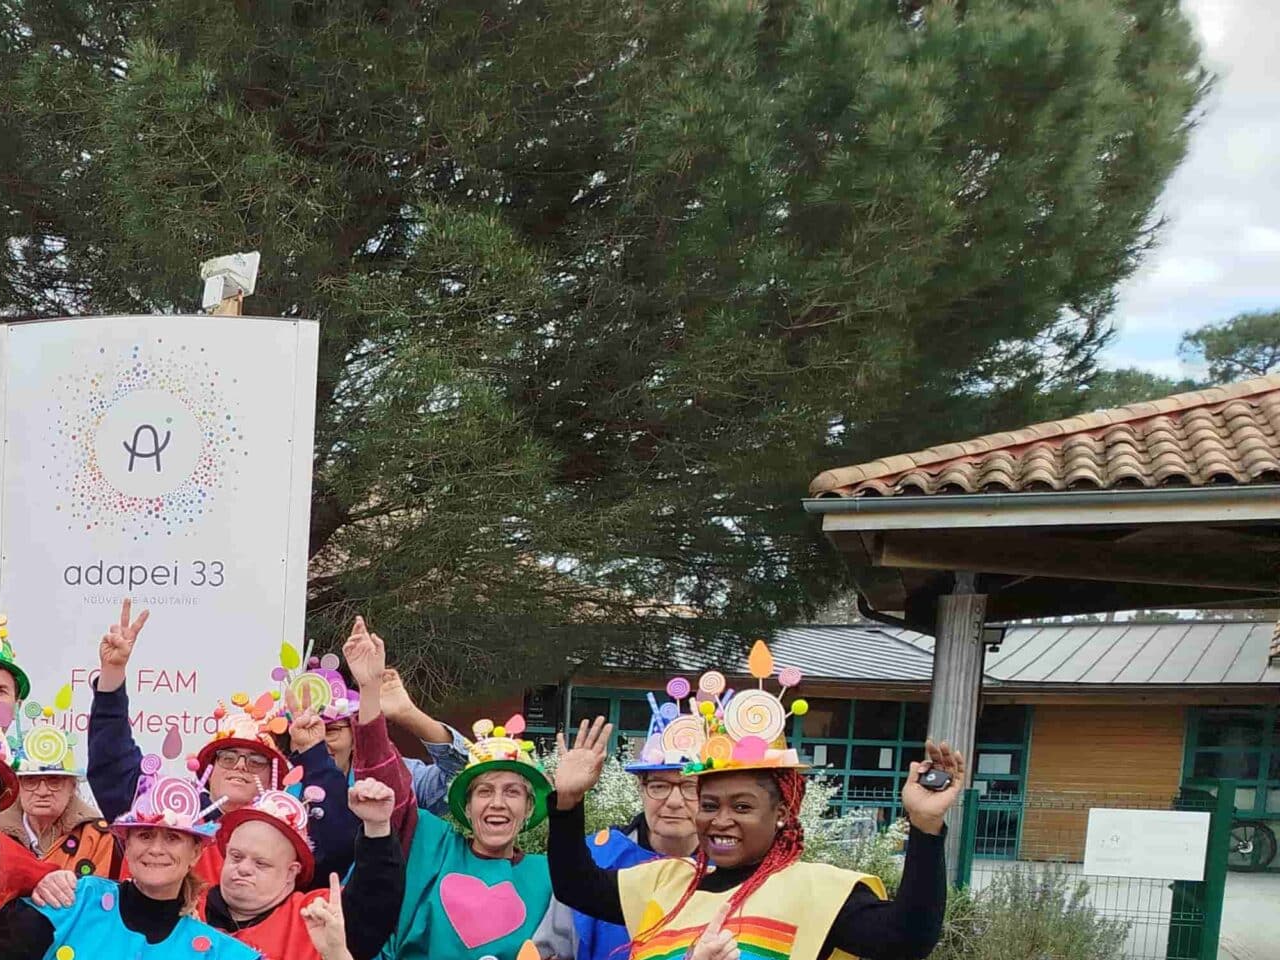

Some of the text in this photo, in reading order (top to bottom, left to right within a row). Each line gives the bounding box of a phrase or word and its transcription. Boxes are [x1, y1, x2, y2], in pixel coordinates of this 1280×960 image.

[63, 559, 225, 591] adapei 33
[83, 596, 138, 605] NOUVEE
[137, 669, 198, 694] FAM
[127, 710, 220, 734] Mestra
